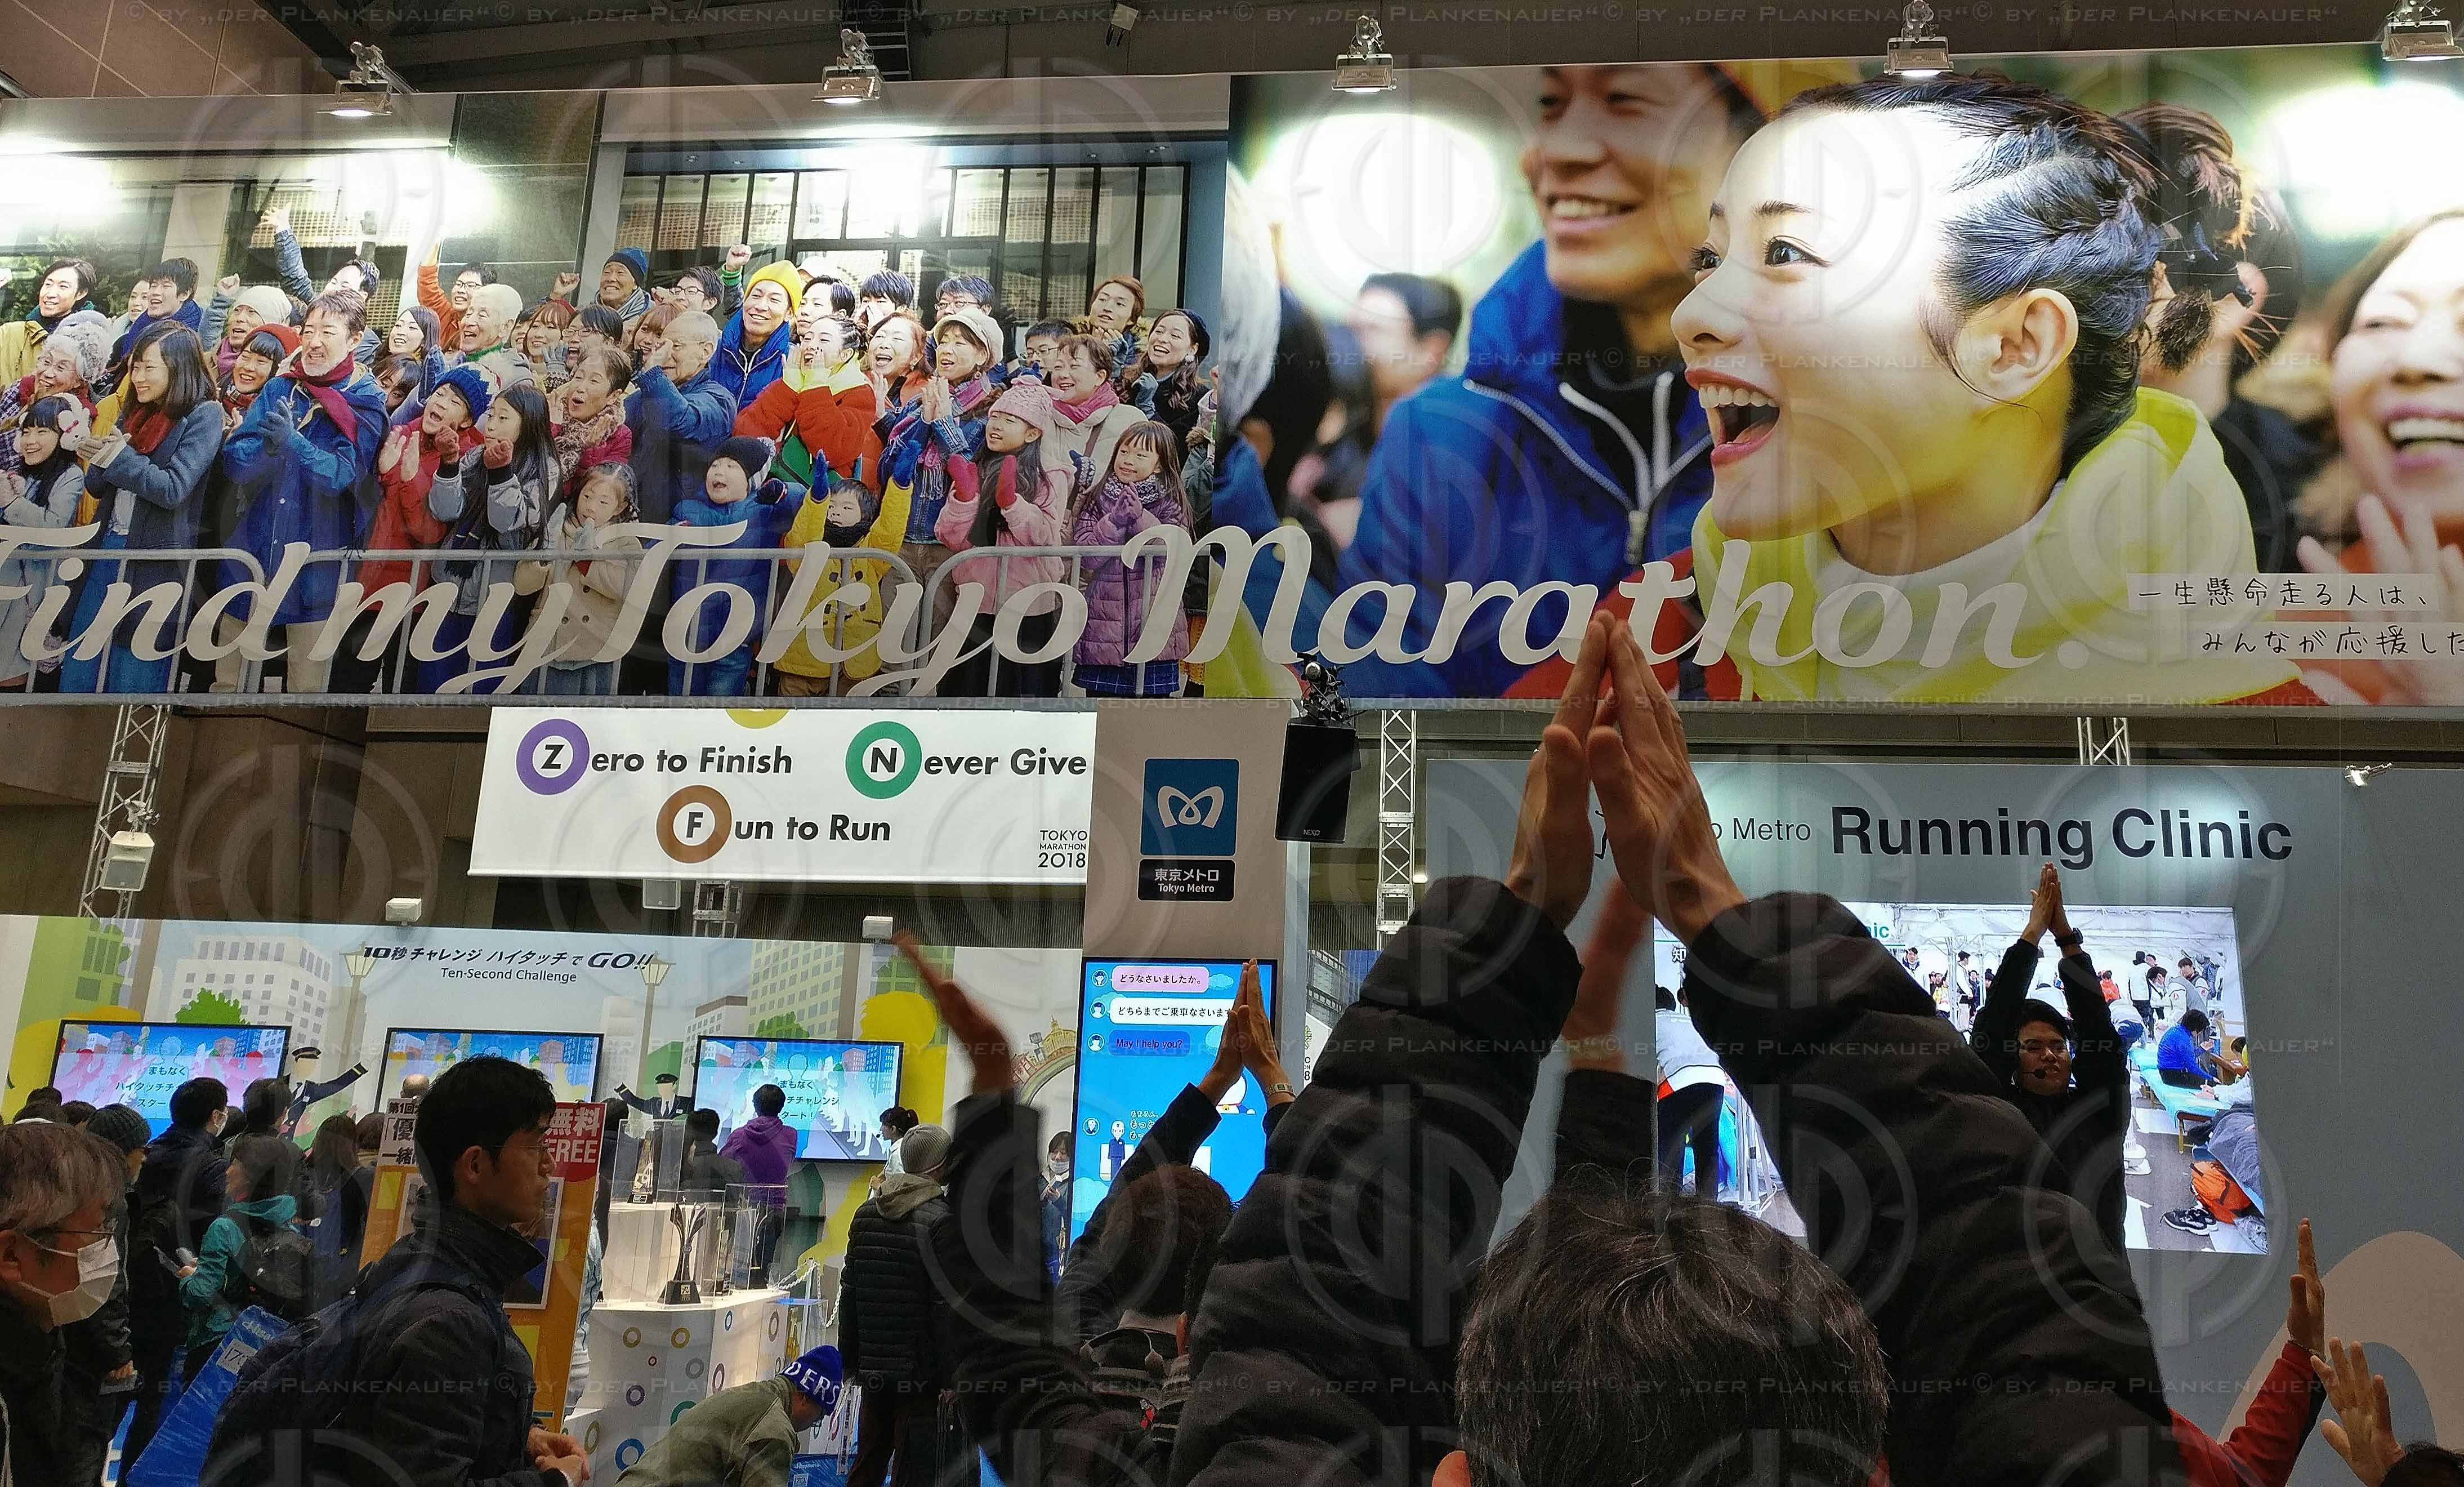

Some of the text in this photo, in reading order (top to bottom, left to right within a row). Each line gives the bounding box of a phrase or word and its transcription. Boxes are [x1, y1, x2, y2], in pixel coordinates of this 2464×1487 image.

[2139, 577, 2427, 607] 一生懸命走る人は、
[0, 519, 2090, 696] Find my Tokyo Marathon.
[2202, 625, 2464, 655] みんなが応援した
[656, 750, 688, 773] to
[699, 746, 792, 774] Finish
[1010, 747, 1087, 776] Give
[787, 817, 819, 840] to
[829, 814, 891, 842] Run
[1040, 830, 1088, 842] TOKYO
[1733, 806, 2293, 870] Metro Running Clinic
[1038, 852, 1086, 869] 2018
[1154, 868, 1219, 882] 東京メトロ
[1158, 883, 1215, 894] Tokyo Metro
[441, 967, 577, 984] Ten-Second Challenge
[1120, 973, 1202, 985] どうなさいましたか。
[1116, 1039, 1133, 1049] May
[1142, 1039, 1159, 1050] help
[1162, 1040, 1182, 1050] you?
[148, 1066, 186, 1076] まもなく
[780, 1080, 813, 1089] まもなく
[547, 1138, 598, 1164] FREE
[783, 1361, 840, 1405] DERS
